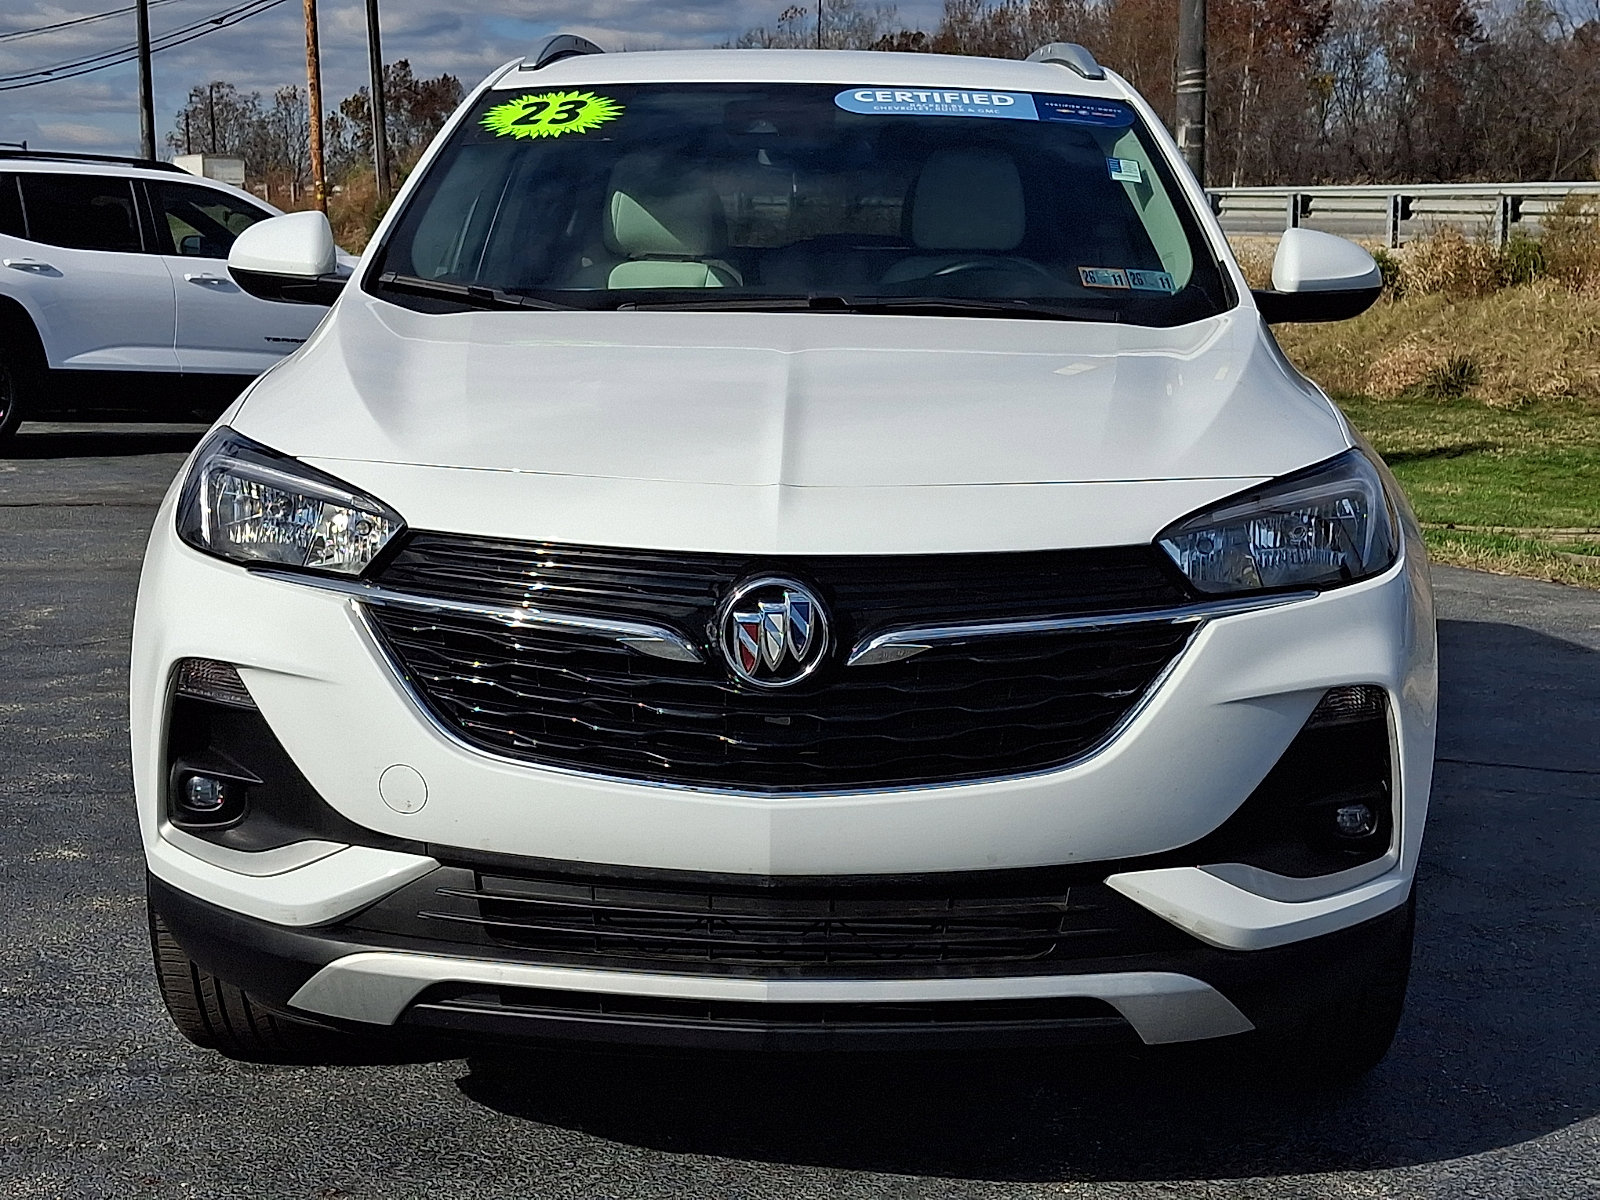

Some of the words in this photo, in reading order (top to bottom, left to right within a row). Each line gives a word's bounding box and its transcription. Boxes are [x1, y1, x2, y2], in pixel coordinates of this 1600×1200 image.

[854, 91, 1015, 106] CERTIFIED
[511, 100, 588, 125] 23
[1082, 270, 1097, 284] 26
[1111, 274, 1124, 287] 11
[1129, 271, 1145, 286] 26
[1159, 276, 1172, 289] 11
